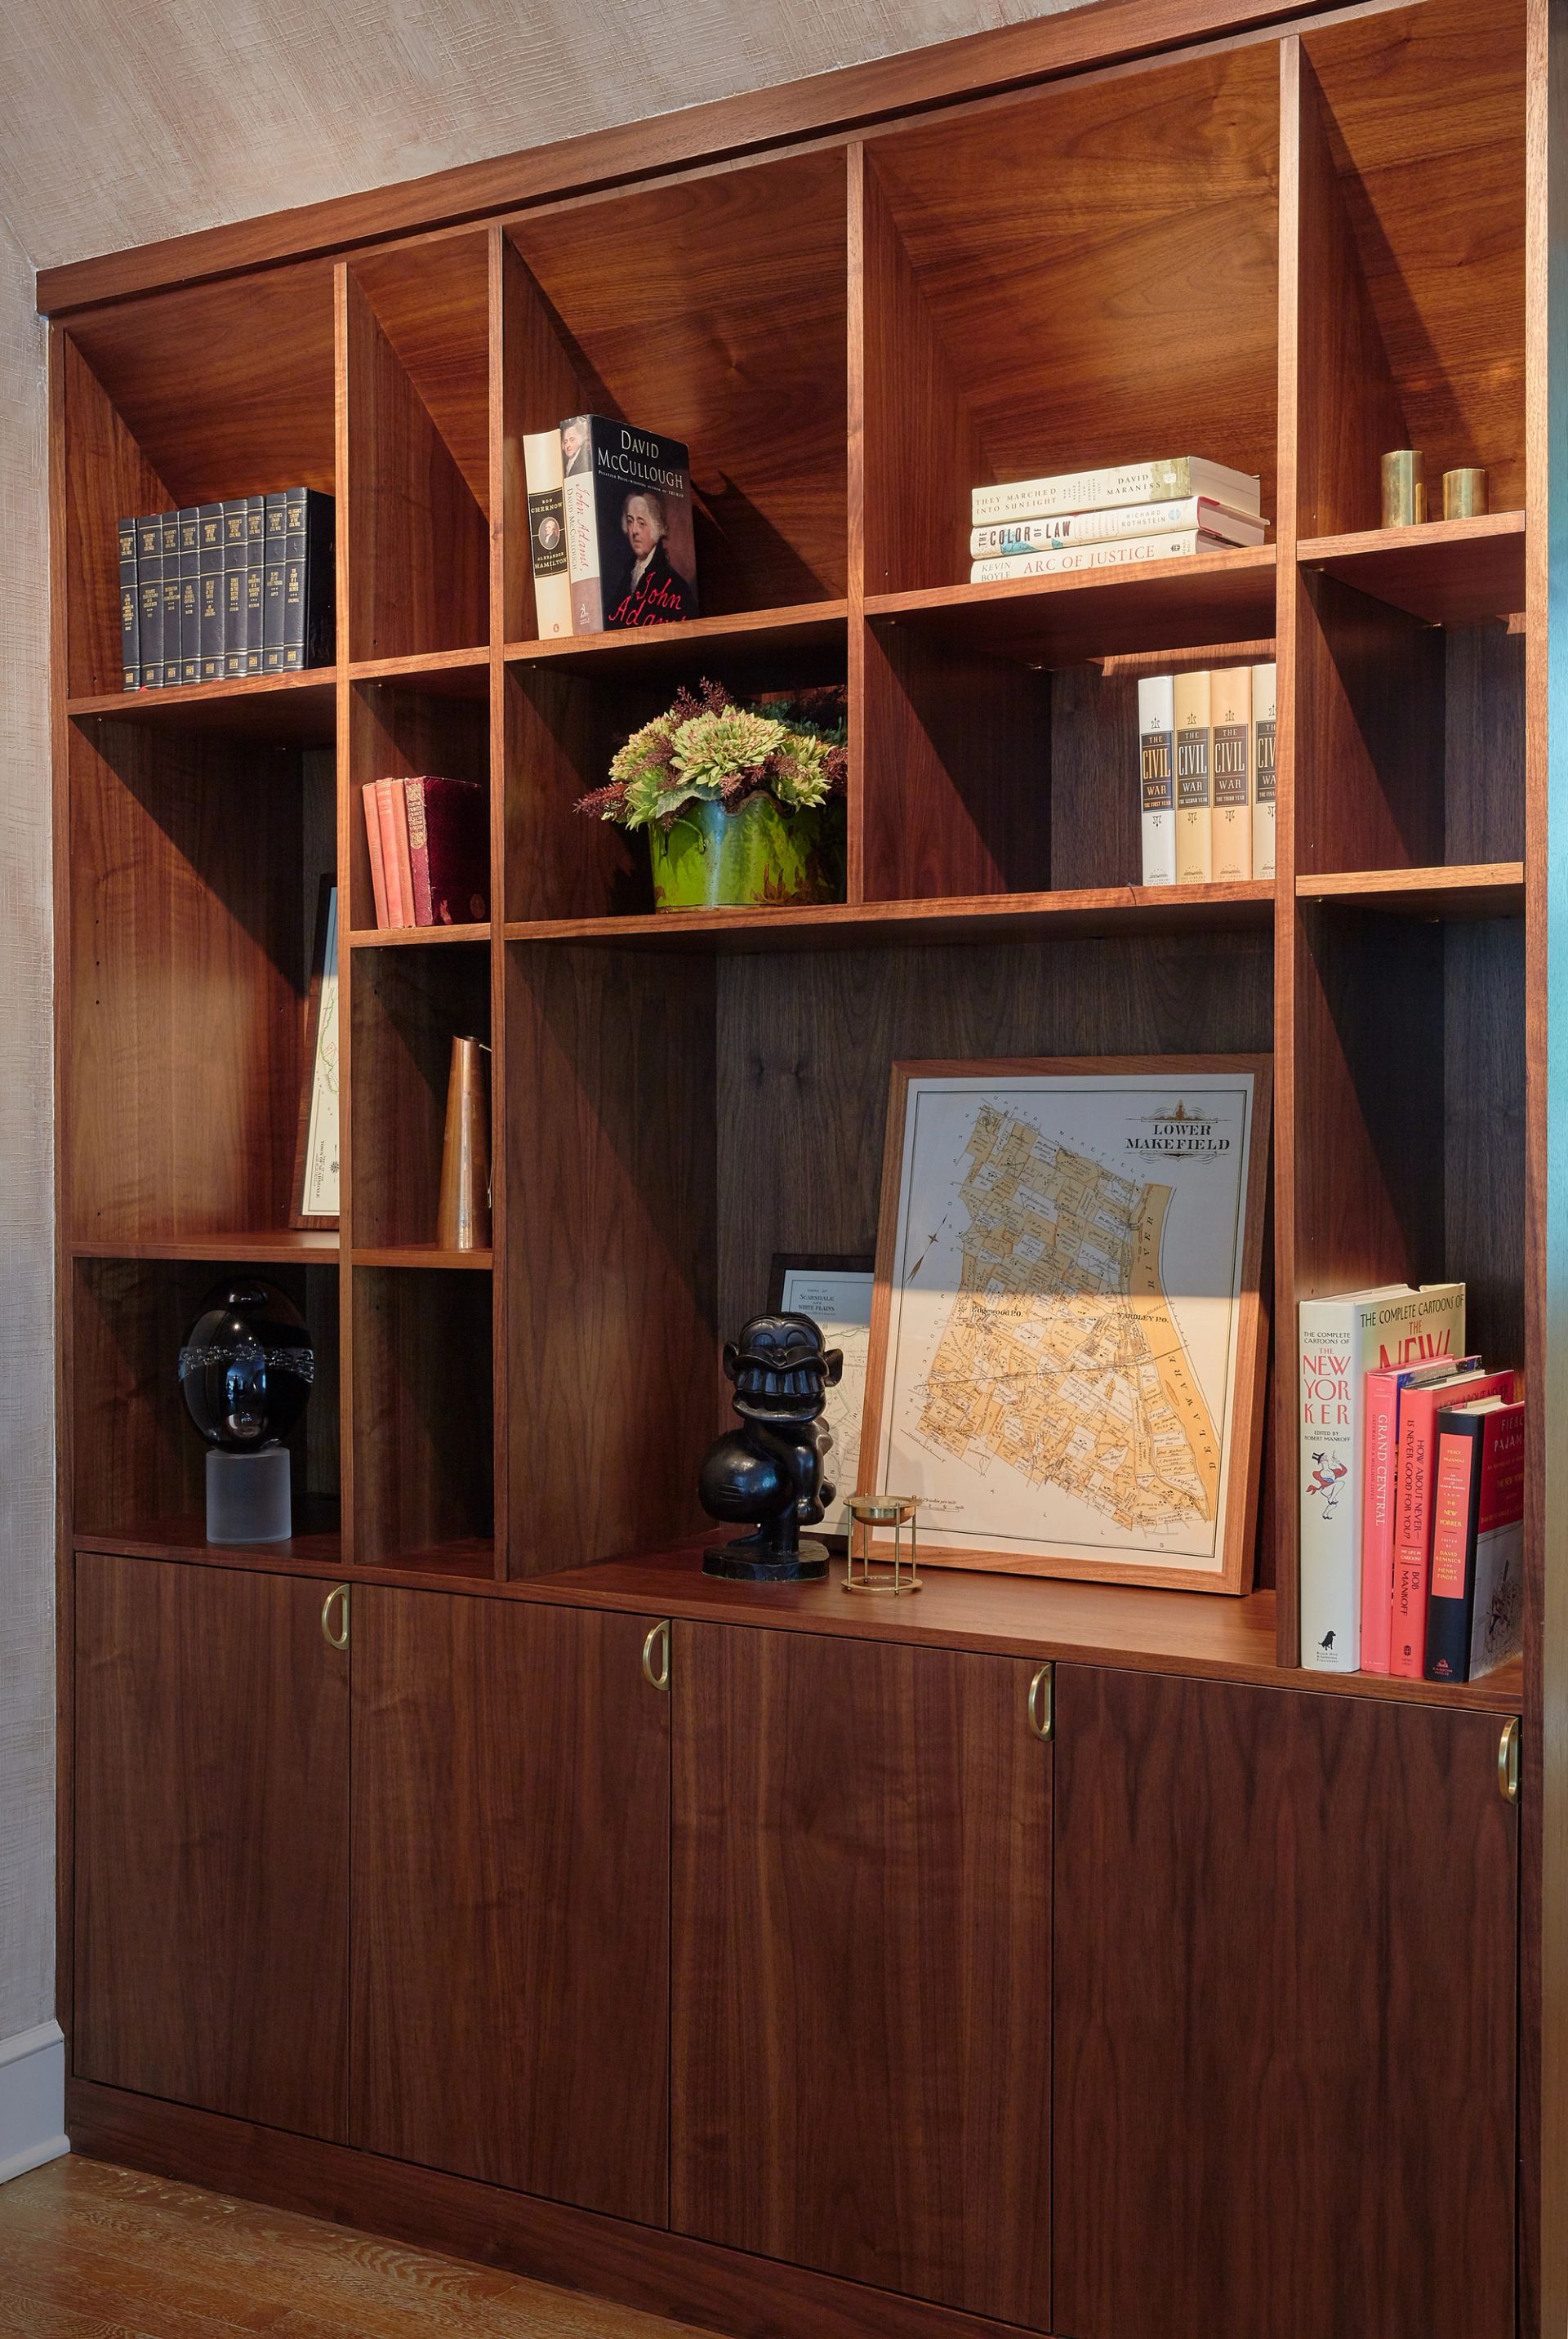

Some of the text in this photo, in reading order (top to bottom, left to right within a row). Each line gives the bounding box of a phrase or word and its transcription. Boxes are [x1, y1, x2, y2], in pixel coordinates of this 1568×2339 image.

[621, 430, 659, 459] DAVID
[1117, 474, 1149, 484] DAVID
[976, 488, 1057, 506] THEY MARCHED
[1106, 482, 1162, 496] MARANISS
[530, 501, 563, 514] CHERNOW
[575, 483, 590, 515] John
[976, 497, 1057, 515] INTO SUNLIGHT
[1120, 516, 1166, 528] ROTHSTEIN
[1126, 509, 1161, 519] RICHARD
[979, 532, 987, 546] THE
[989, 526, 1030, 546] COLOR
[1033, 528, 1042, 537] OF
[1045, 520, 1071, 539] LAW
[534, 557, 567, 568] HAMILTON
[537, 552, 565, 561] ALEXANDER
[1023, 545, 1156, 575] ARC OF JUSTICE
[982, 561, 1012, 572] KEVIN
[981, 572, 1011, 581] BOYLE
[635, 572, 682, 610] John
[1149, 735, 1163, 744] THE
[1185, 731, 1199, 740] THE
[1223, 728, 1237, 737] THE
[1178, 744, 1208, 777] CIVIL
[1215, 741, 1245, 773] CIVIL
[1258, 737, 1276, 769] CIV
[1143, 747, 1171, 780] CIVIL
[1183, 781, 1202, 792] WAR
[1219, 779, 1241, 791] WAR
[1263, 775, 1276, 786] WA
[1147, 785, 1166, 796] WAR
[1152, 1124, 1211, 1136] LOWER
[1125, 1138, 1230, 1151] MAKEFIELD
[1143, 1216, 1156, 1289] RIVER
[972, 1306, 1010, 1317] Edgewood
[1117, 1312, 1153, 1321] YARDLEY
[1360, 1294, 1464, 1328] THE COMPLETE CARTOONS OF
[1409, 1320, 1422, 1335] THE
[1379, 1328, 1451, 1370] NEW
[1302, 1355, 1352, 1376] NEW
[1303, 1378, 1352, 1401] YOR
[1168, 1356, 1216, 1469] DELAWARE
[1303, 1403, 1351, 1425] KER
[1501, 1415, 1524, 1432] FIERC
[1494, 1432, 1523, 1452] PAJAM
[1415, 1439, 1425, 1465] HOW
[1375, 1415, 1388, 1526] GRAND CENTRAL
[1403, 1419, 1415, 1539] IS NEVER GOOD FOR YOU?
[1414, 1468, 1424, 1499] ABOUT
[1439, 1519, 1462, 1527] YORKER
[1411, 1571, 1420, 1590] BOB
[1437, 1573, 1458, 1581] FINDER
[1400, 1570, 1410, 1617] MANKOFF
